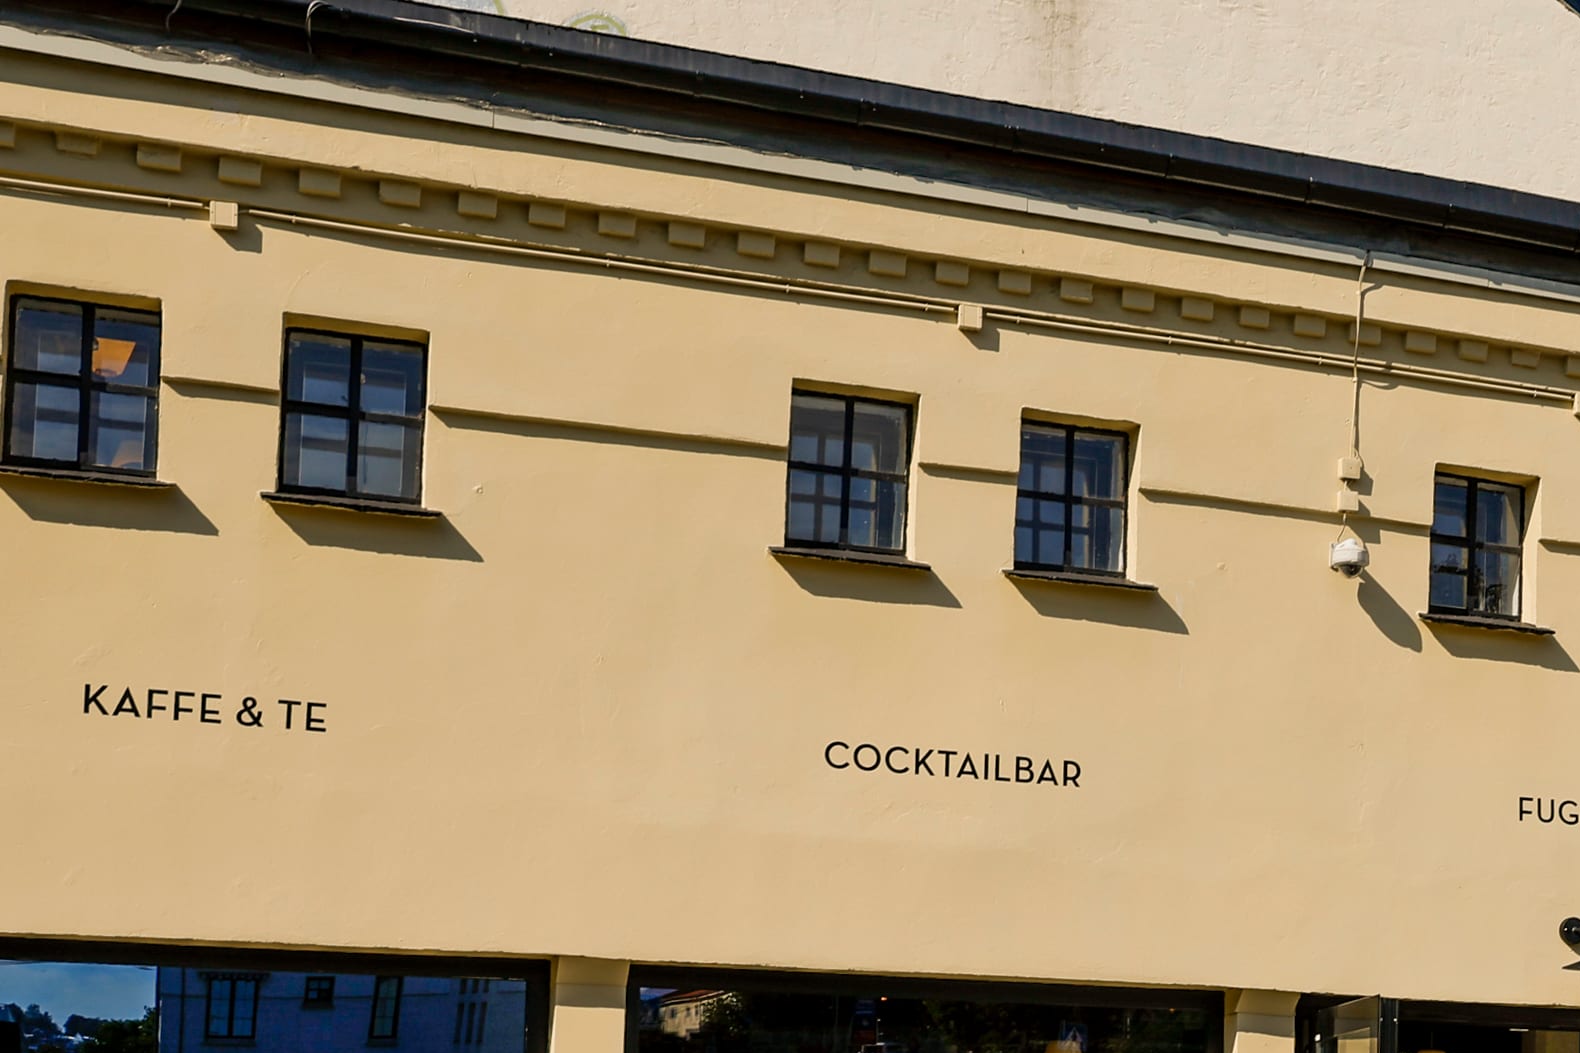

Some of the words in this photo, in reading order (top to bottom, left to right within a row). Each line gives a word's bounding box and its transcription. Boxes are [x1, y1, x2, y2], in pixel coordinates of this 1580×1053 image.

[83, 684, 222, 724] KAFFE
[236, 696, 264, 727] &
[278, 699, 327, 732] TE
[824, 741, 1082, 788] COCKTAILBAR
